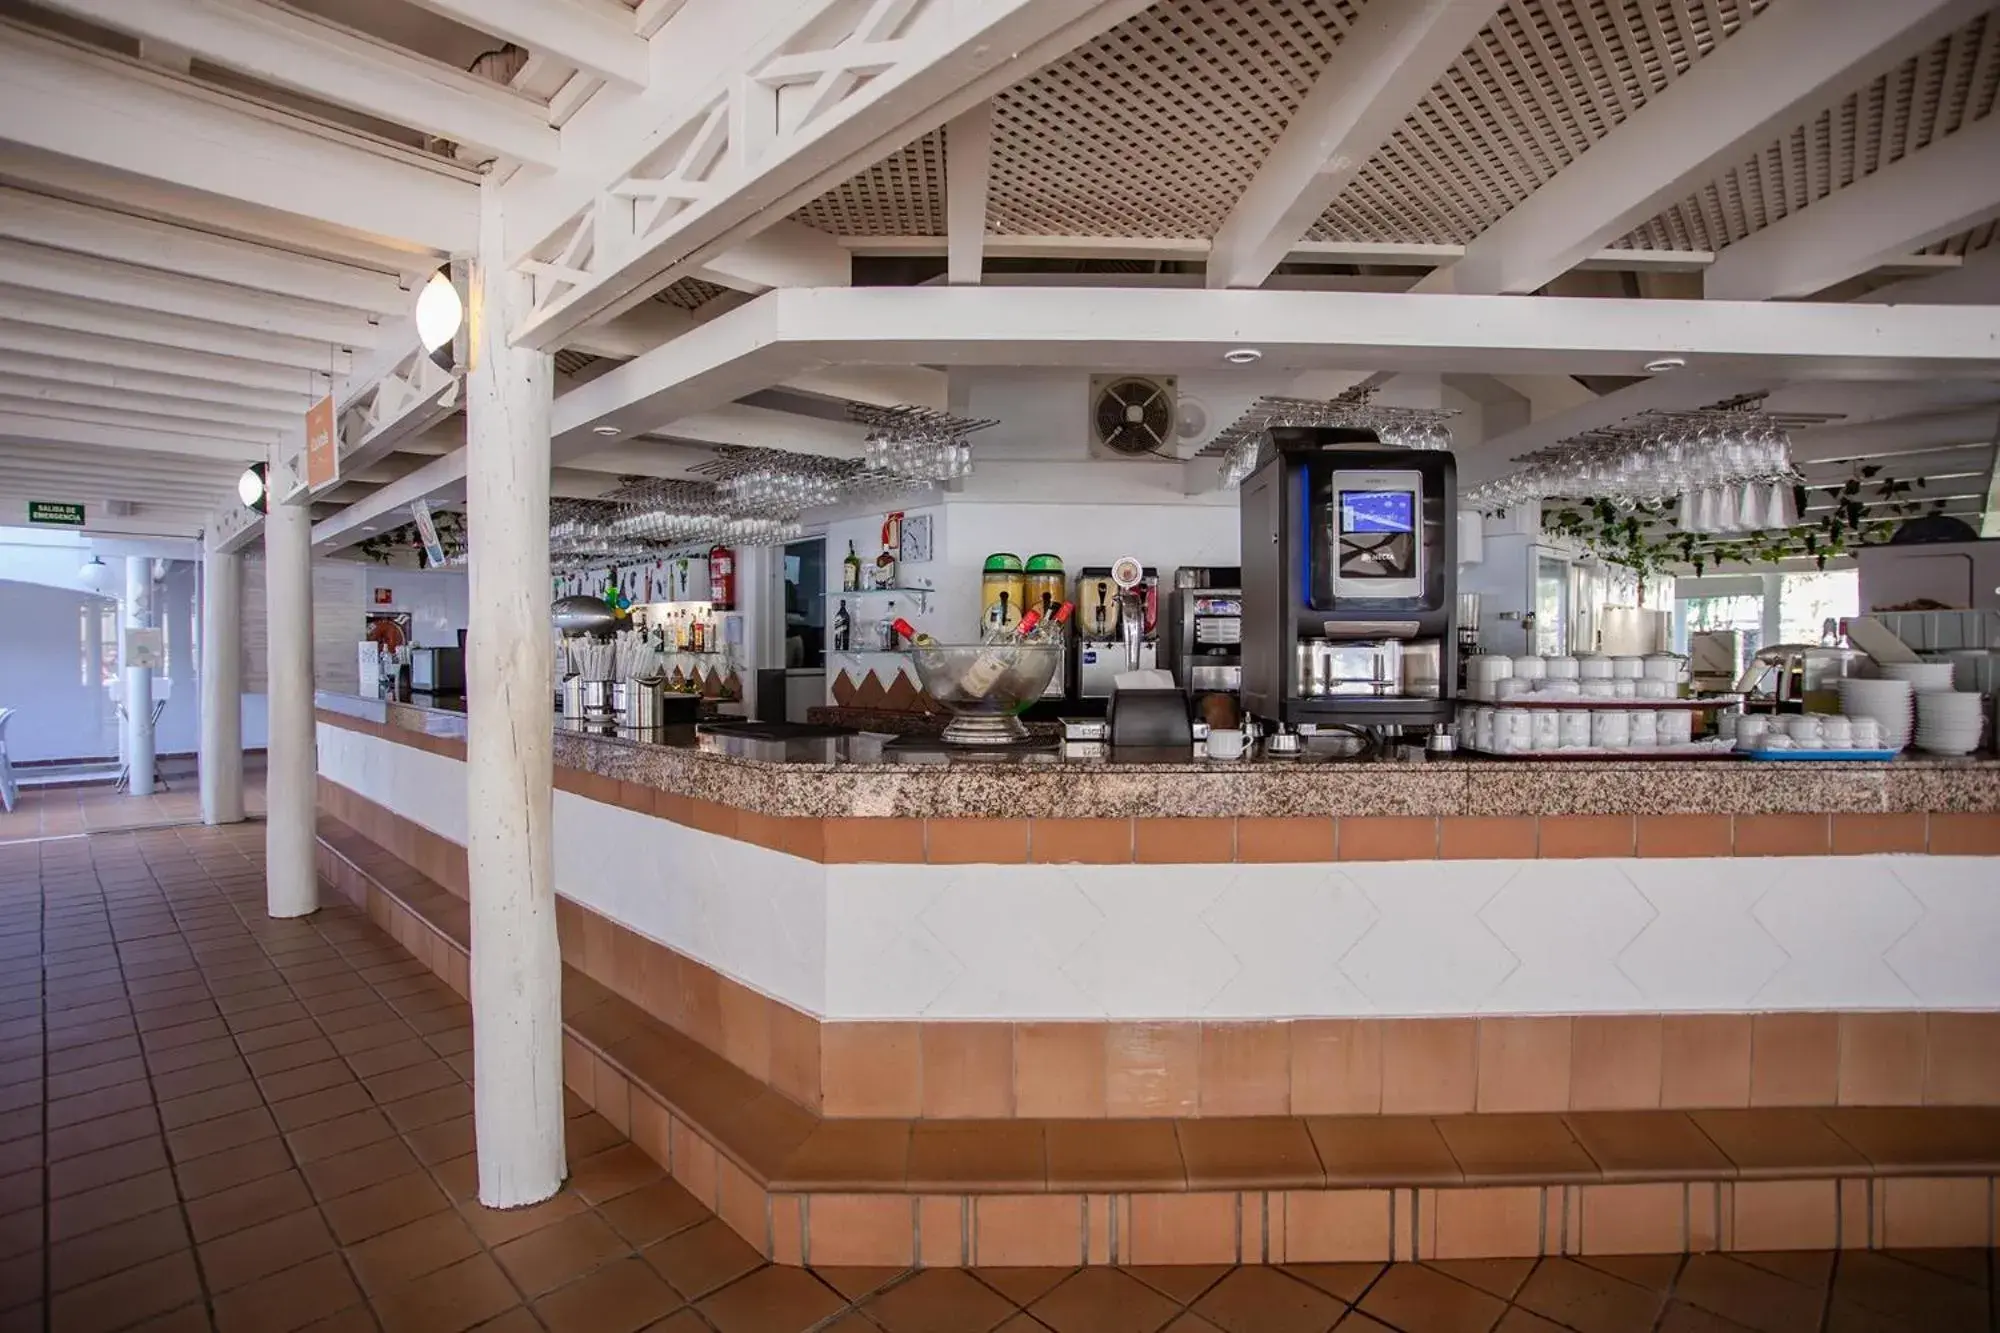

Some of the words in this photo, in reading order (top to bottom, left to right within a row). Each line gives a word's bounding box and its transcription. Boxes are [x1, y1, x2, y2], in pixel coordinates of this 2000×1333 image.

[38, 504, 65, 512] SALIDA
[66, 506, 76, 514] DE
[33, 511, 81, 521] EMERGENCIA
